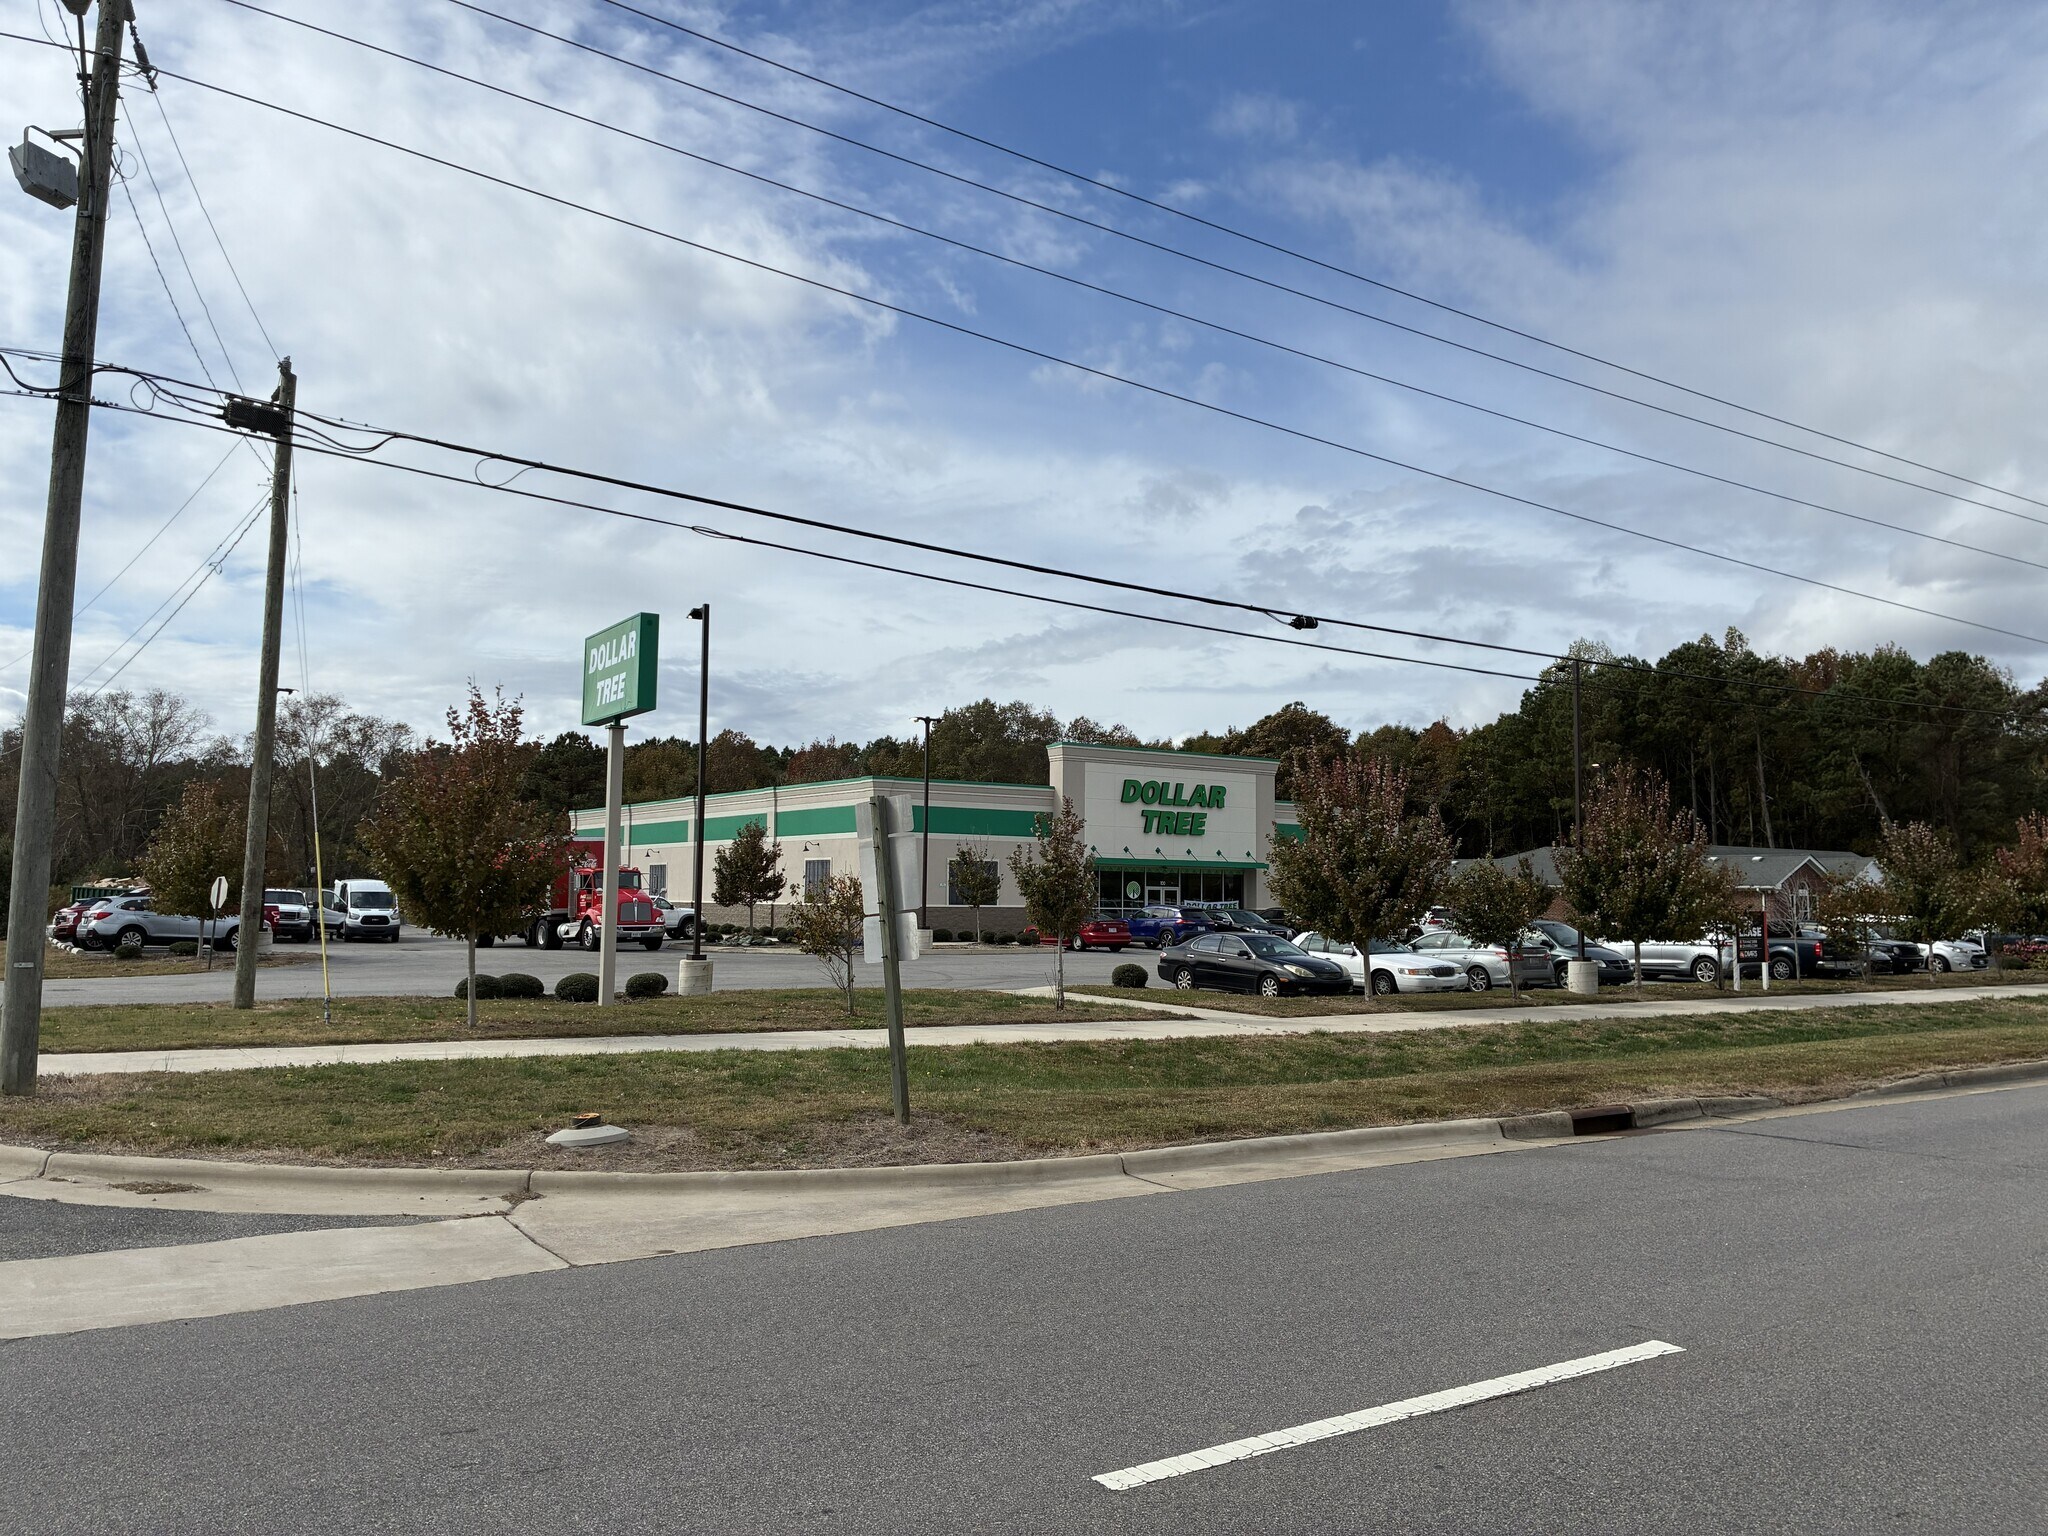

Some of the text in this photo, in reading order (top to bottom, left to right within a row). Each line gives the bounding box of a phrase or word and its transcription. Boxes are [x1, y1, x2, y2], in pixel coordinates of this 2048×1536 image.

[589, 630, 636, 674] DOLLAR
[596, 672, 626, 706] TREE
[1121, 779, 1226, 808] DOLLAR
[1141, 809, 1207, 835] TREE
